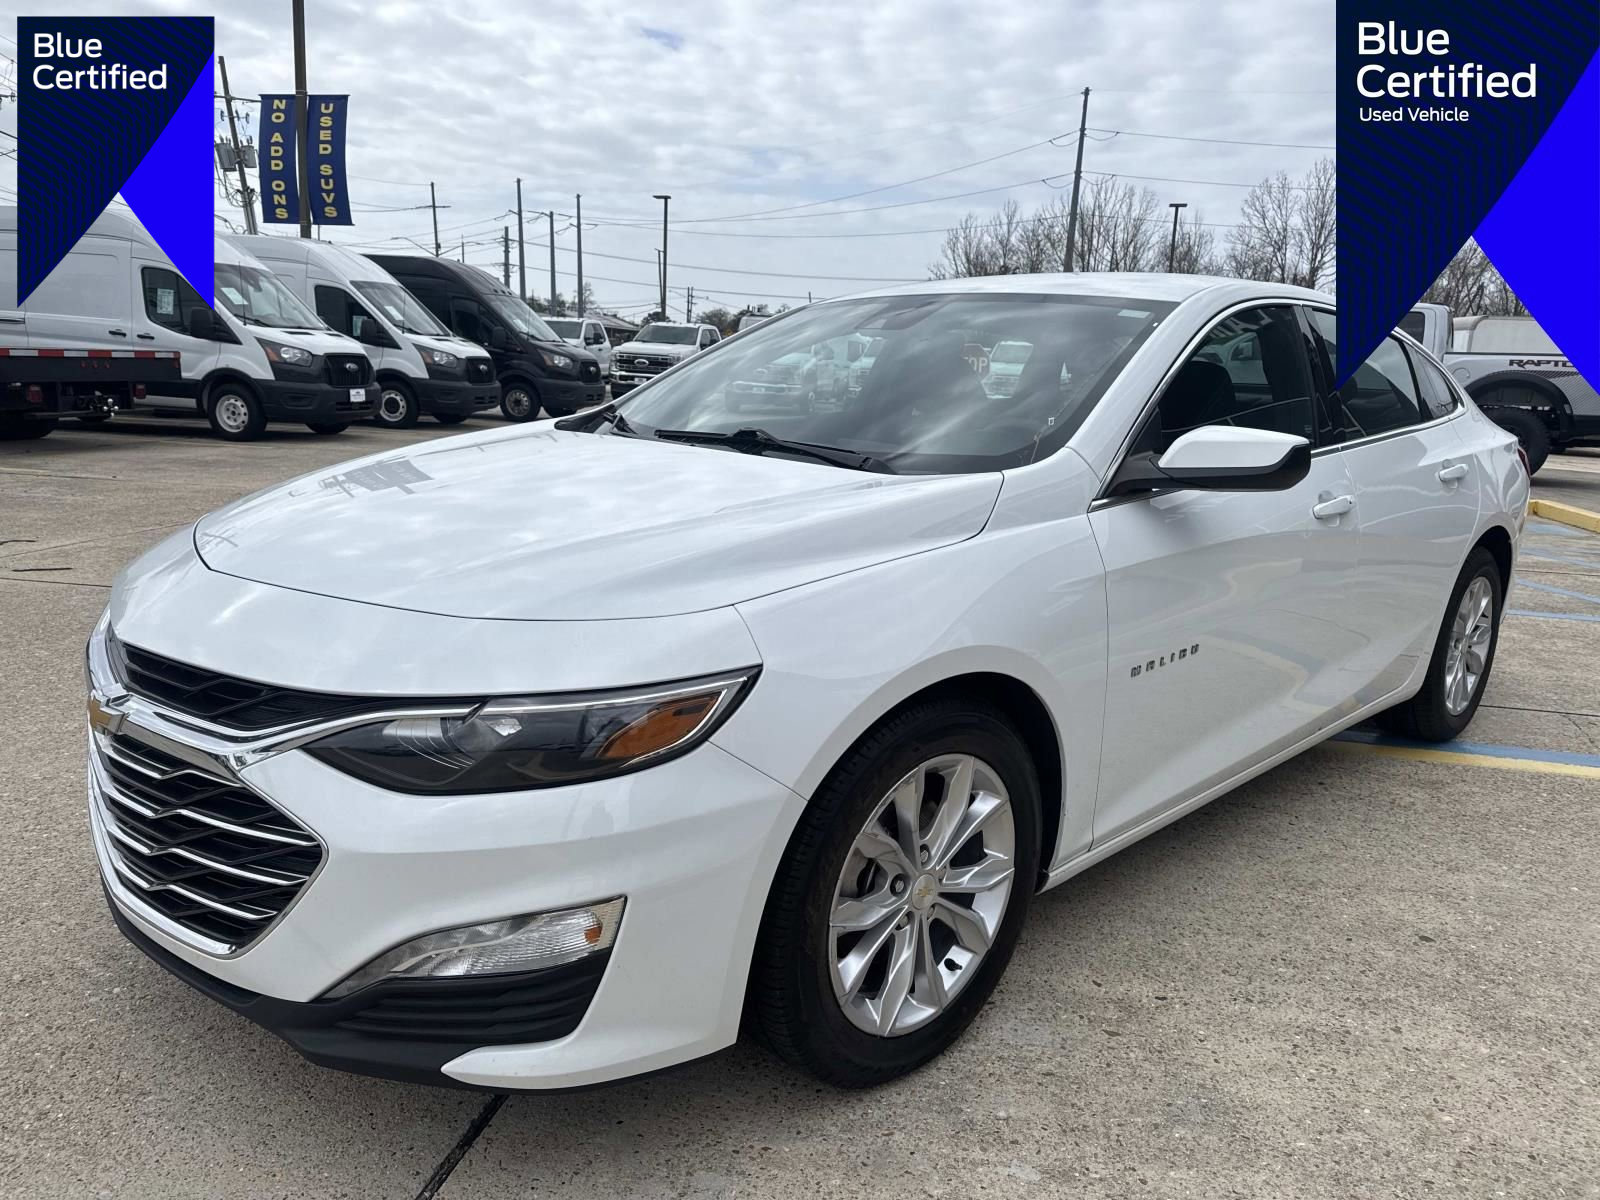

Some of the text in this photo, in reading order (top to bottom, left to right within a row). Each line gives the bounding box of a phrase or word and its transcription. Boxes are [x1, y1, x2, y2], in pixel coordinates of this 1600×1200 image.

[270, 99, 289, 219] NO ADD ONS
[319, 103, 338, 218] USED SUVS
[1508, 359, 1575, 370] RAPTO
[1130, 643, 1200, 678] MALIBU
